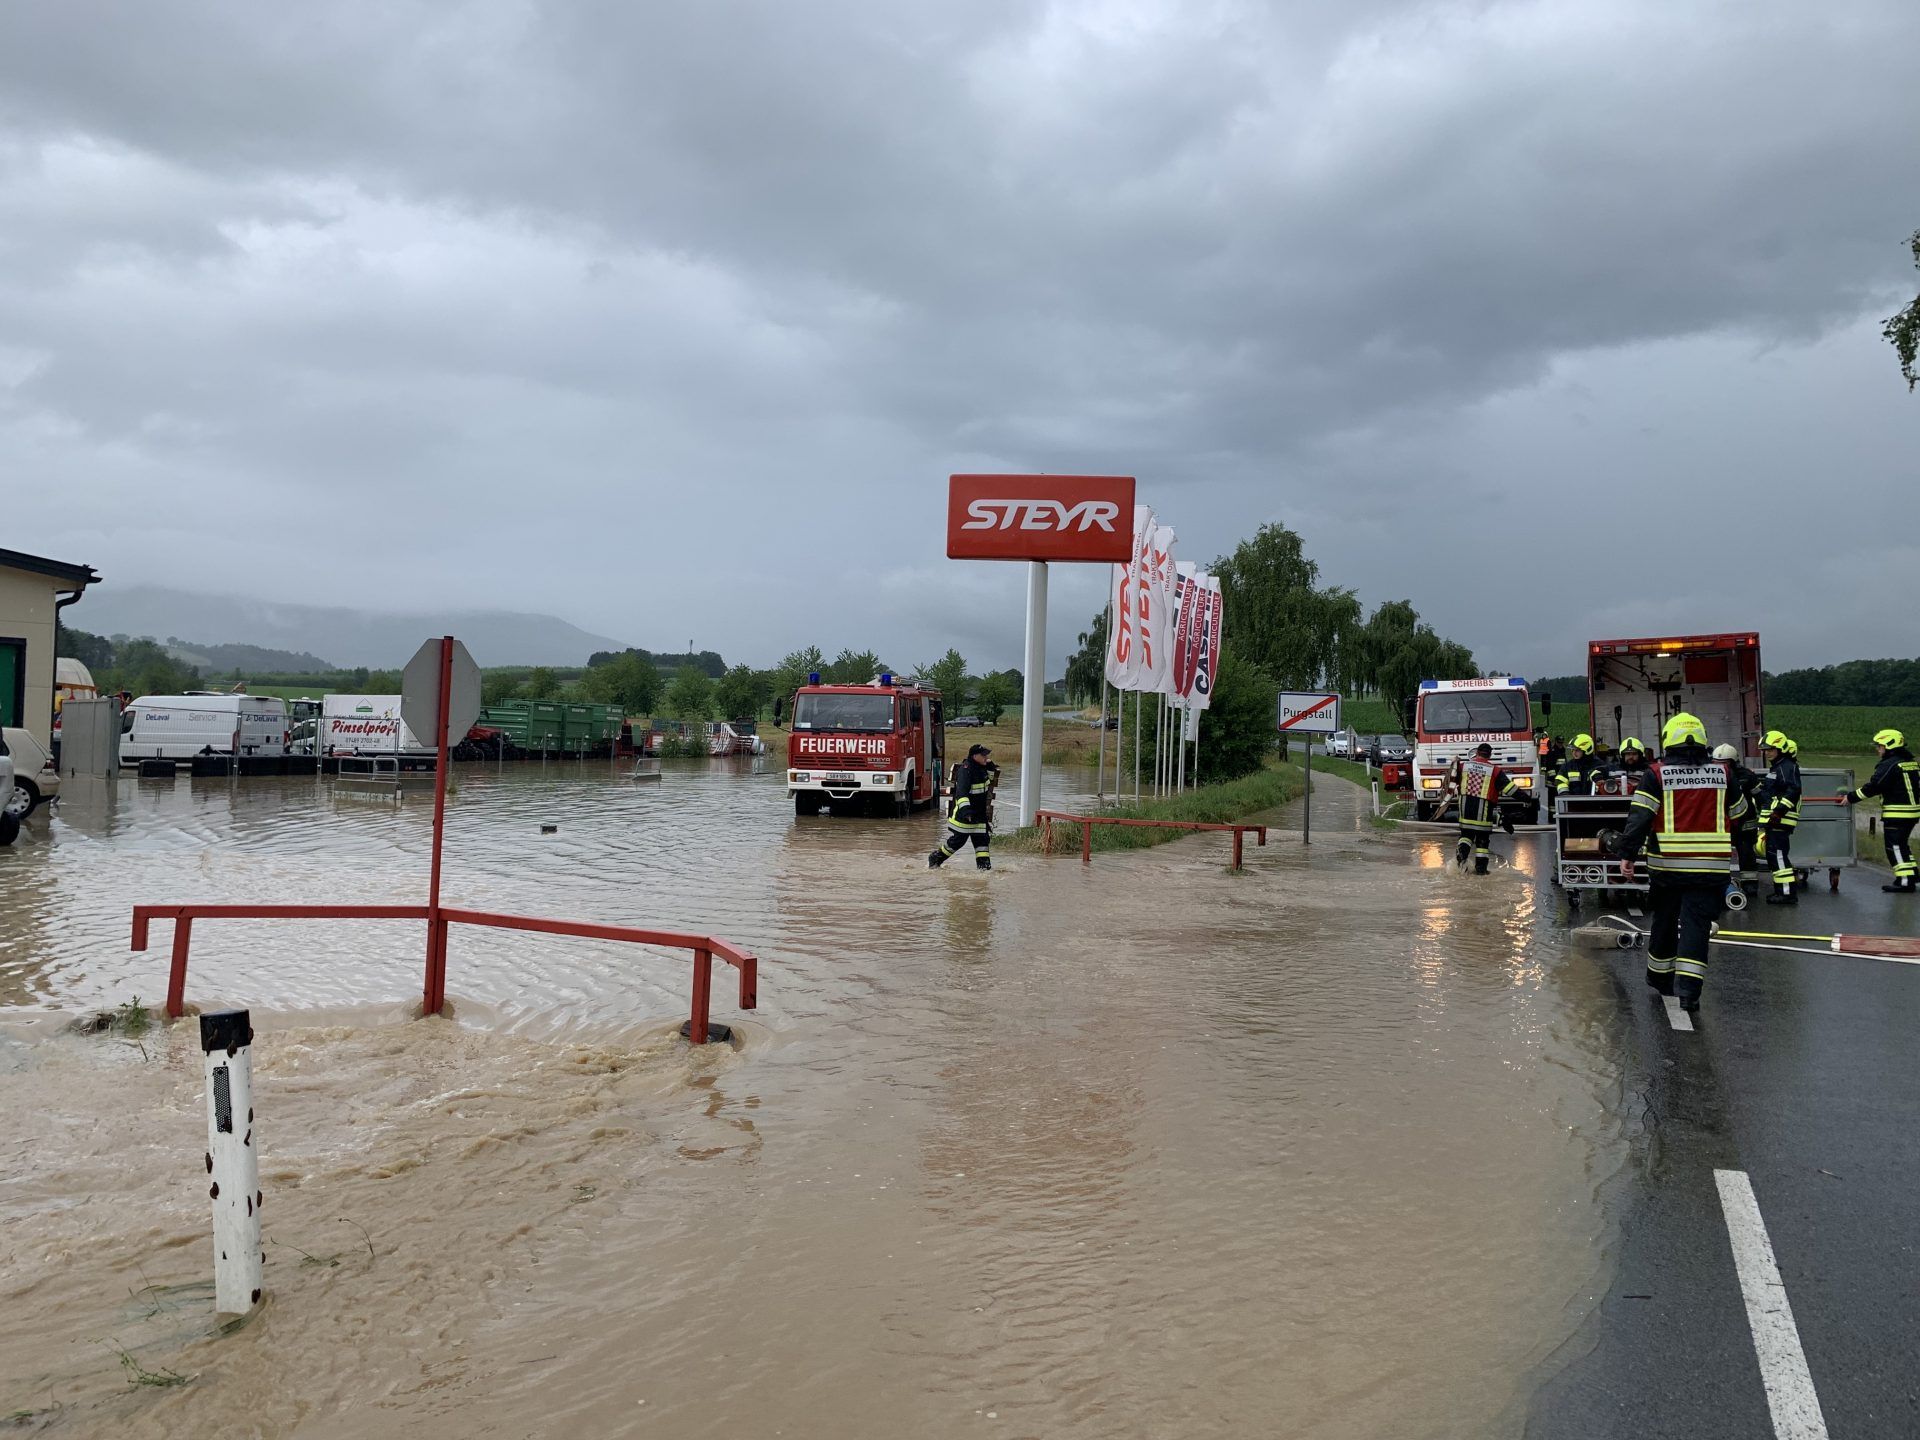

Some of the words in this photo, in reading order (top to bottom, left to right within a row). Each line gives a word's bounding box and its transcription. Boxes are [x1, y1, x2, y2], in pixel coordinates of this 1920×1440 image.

[961, 499, 1119, 532] STEYR
[1116, 562, 1132, 664] STEY
[1178, 580, 1195, 642] AGRICULTURE
[1192, 589, 1206, 649] AGRICULTURE
[1210, 594, 1221, 651] AGRICULTURE
[1452, 679, 1495, 688] SCHEIBBS
[145, 713, 170, 721] DeLaval
[188, 712, 217, 722] Service
[253, 714, 278, 723] DeLaval
[1283, 707, 1332, 720] Purgstall
[1440, 733, 1512, 743] FEUERWEHR
[800, 738, 886, 754] FEUERWEHR
[1662, 767, 1701, 776] GRKDT
[1703, 767, 1725, 775] VFA
[1676, 777, 1726, 786] PURGSTALL
